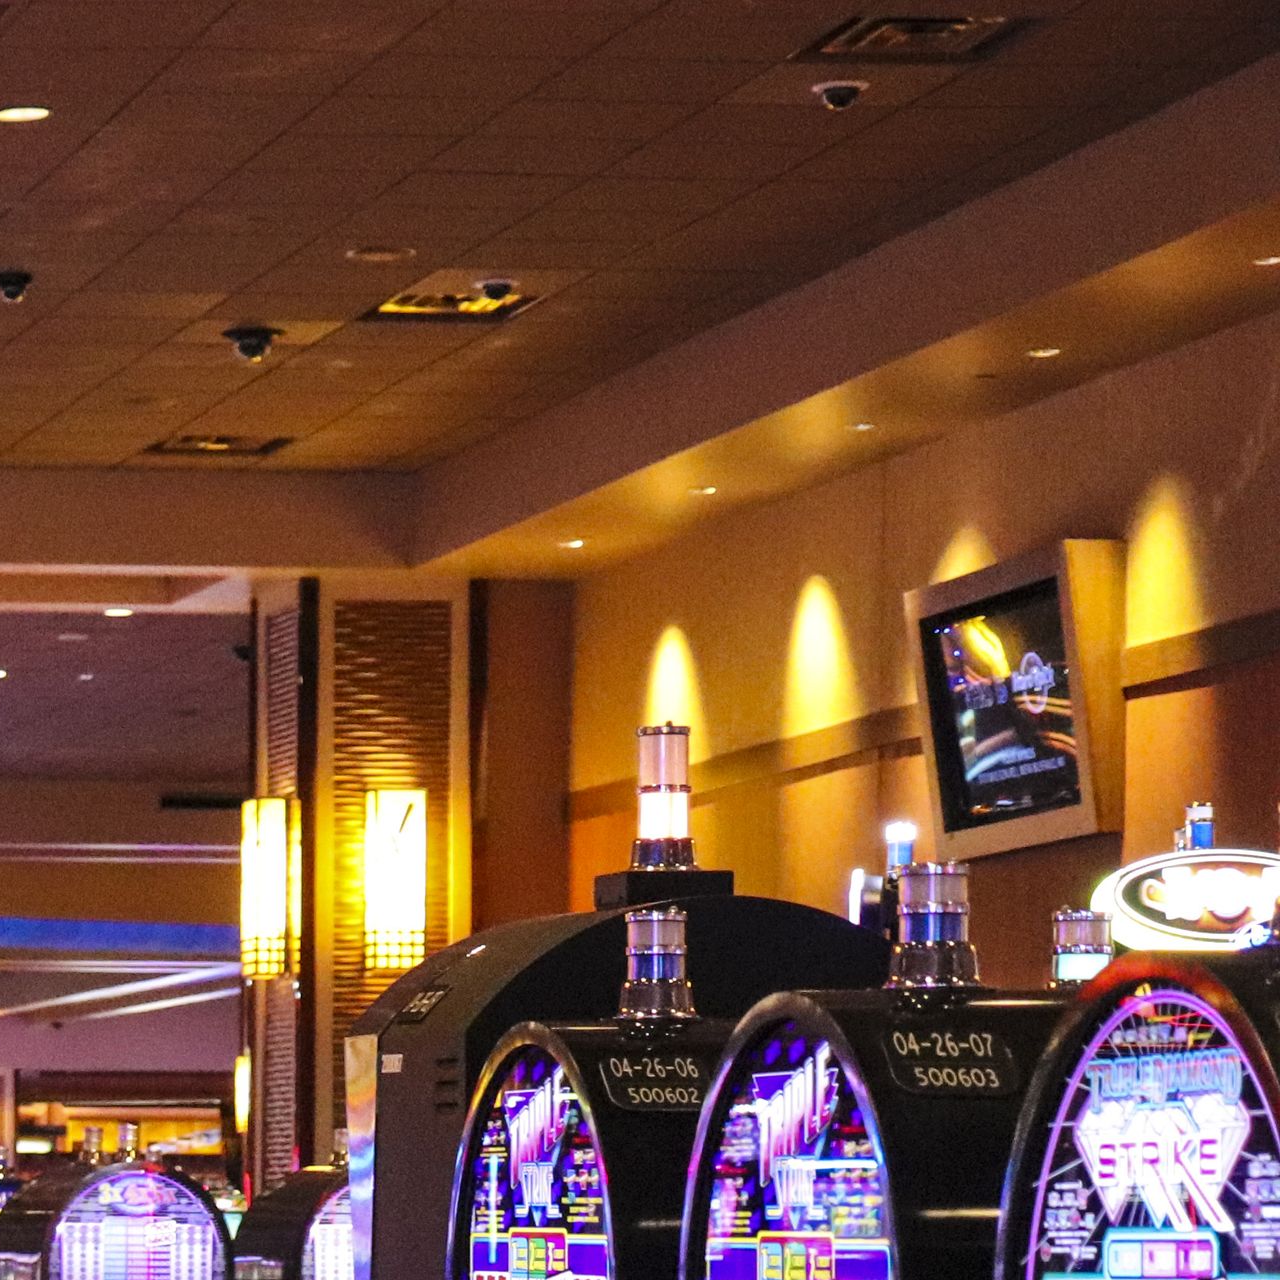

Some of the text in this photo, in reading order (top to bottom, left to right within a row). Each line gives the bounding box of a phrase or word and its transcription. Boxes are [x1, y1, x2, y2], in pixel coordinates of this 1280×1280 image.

[893, 1031, 992, 1056] 04-26-07
[610, 1057, 699, 1078] 04-26-06
[914, 1067, 999, 1087] 500603
[629, 1088, 700, 1105] 500602
